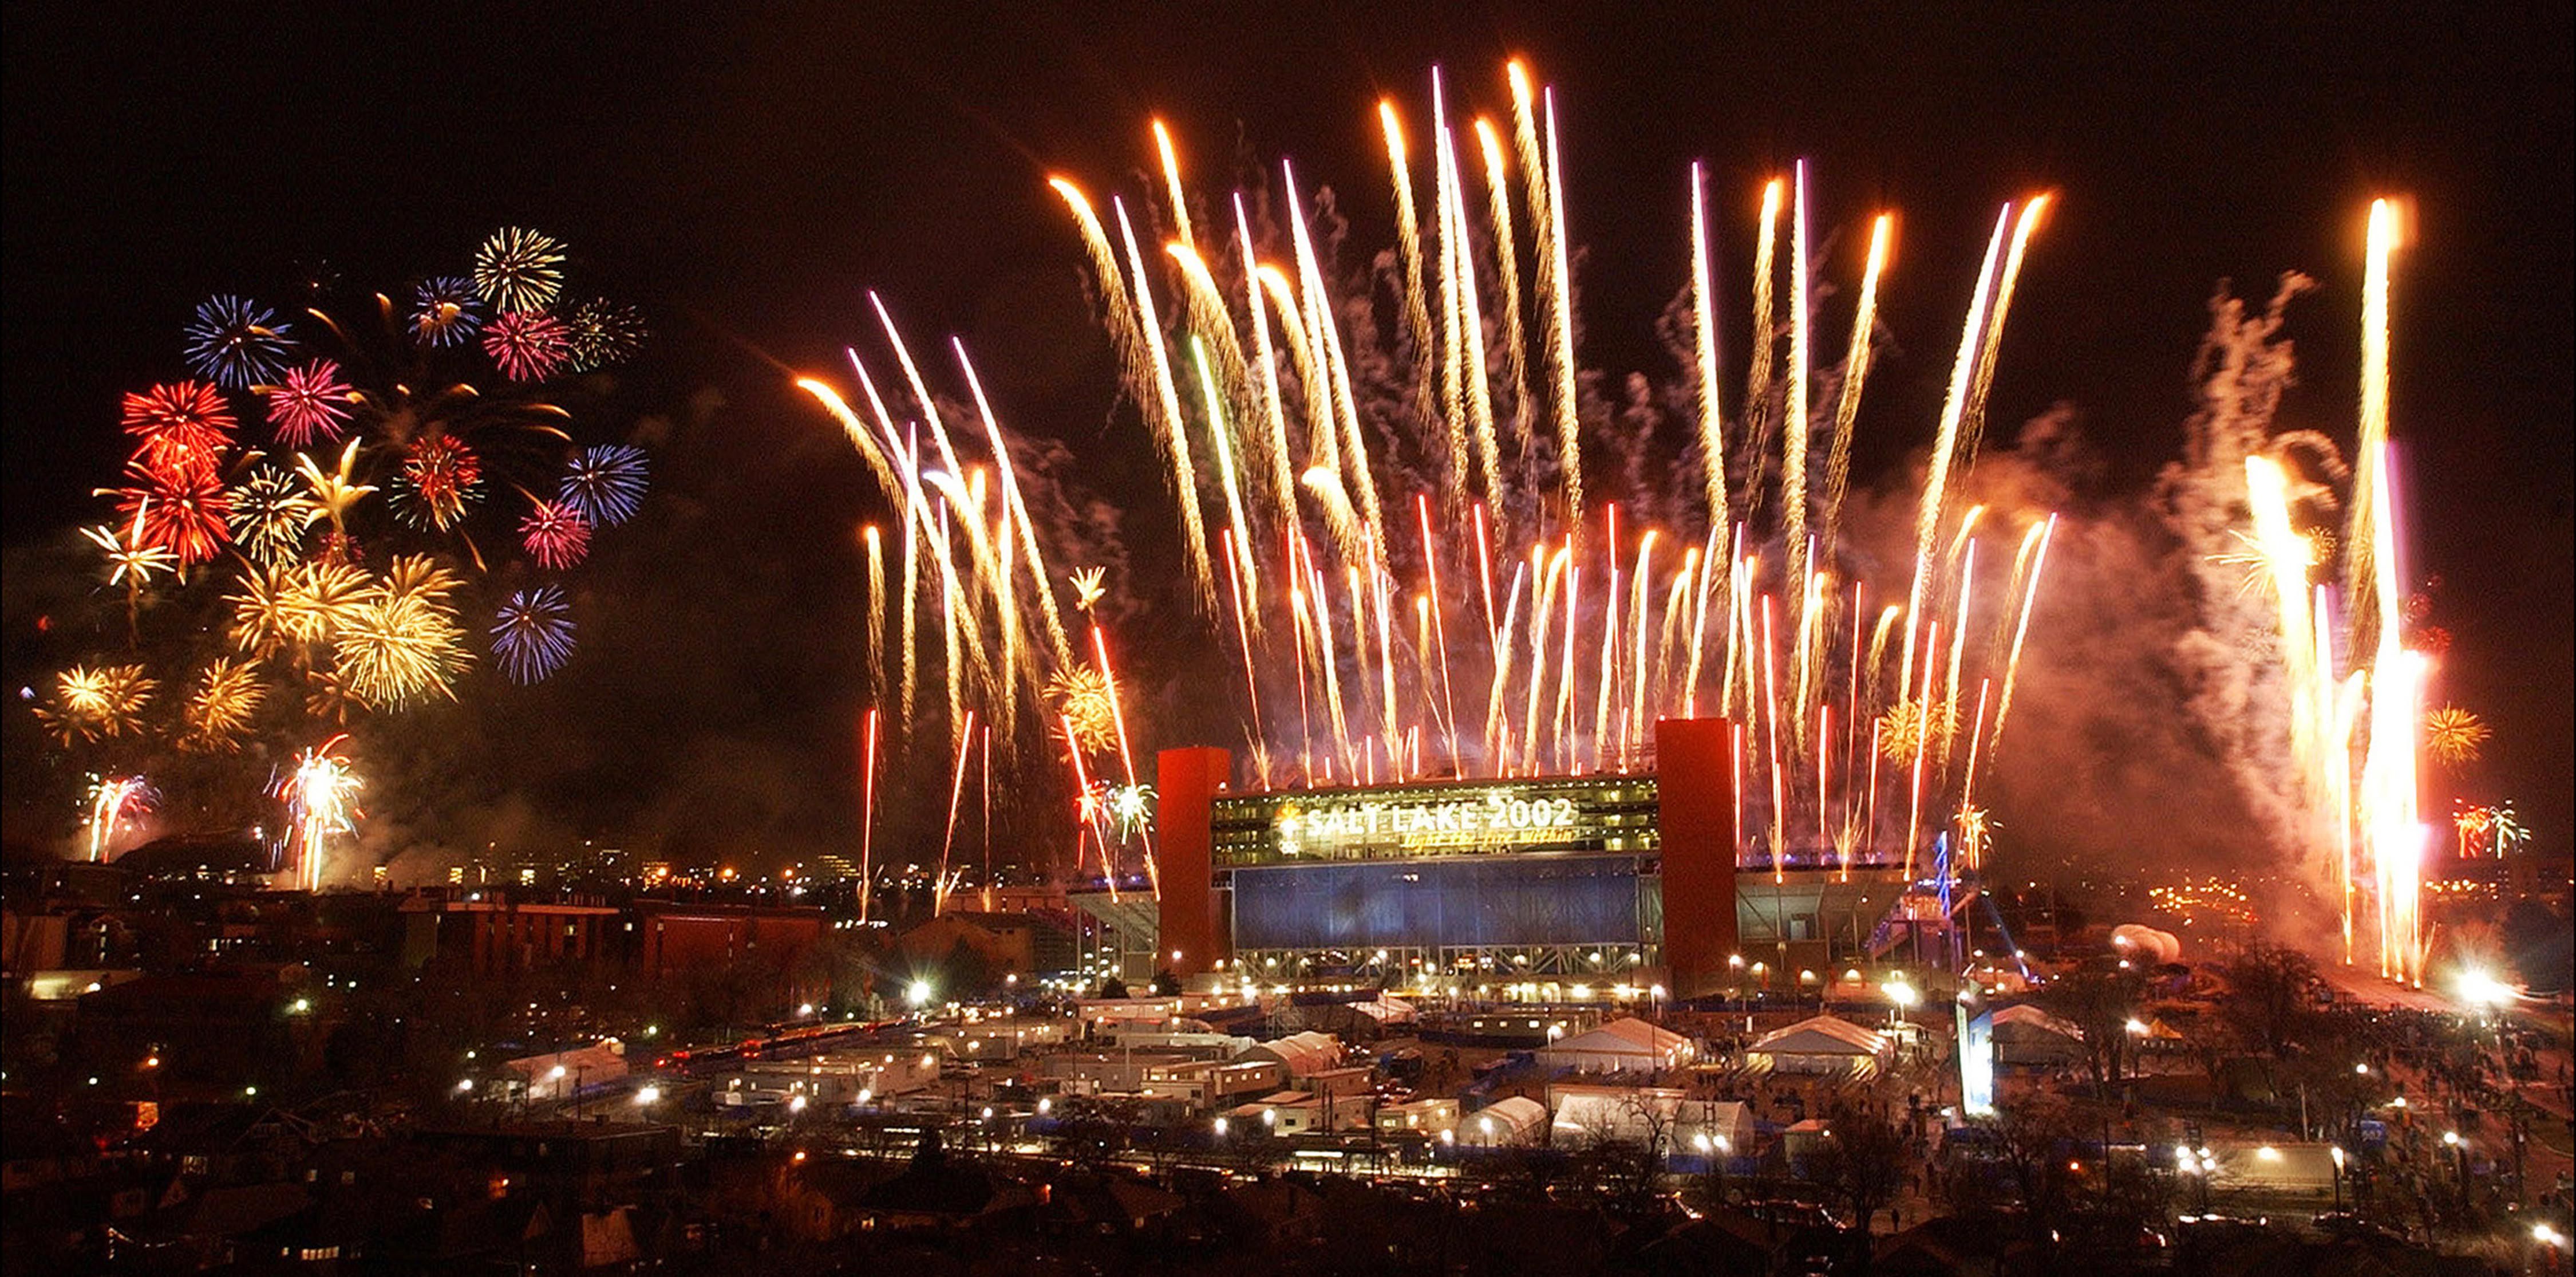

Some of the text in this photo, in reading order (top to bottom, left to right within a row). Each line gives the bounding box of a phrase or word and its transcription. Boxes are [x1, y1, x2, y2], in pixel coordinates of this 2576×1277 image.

[1307, 798, 1574, 837] SALT LAKE 2002
